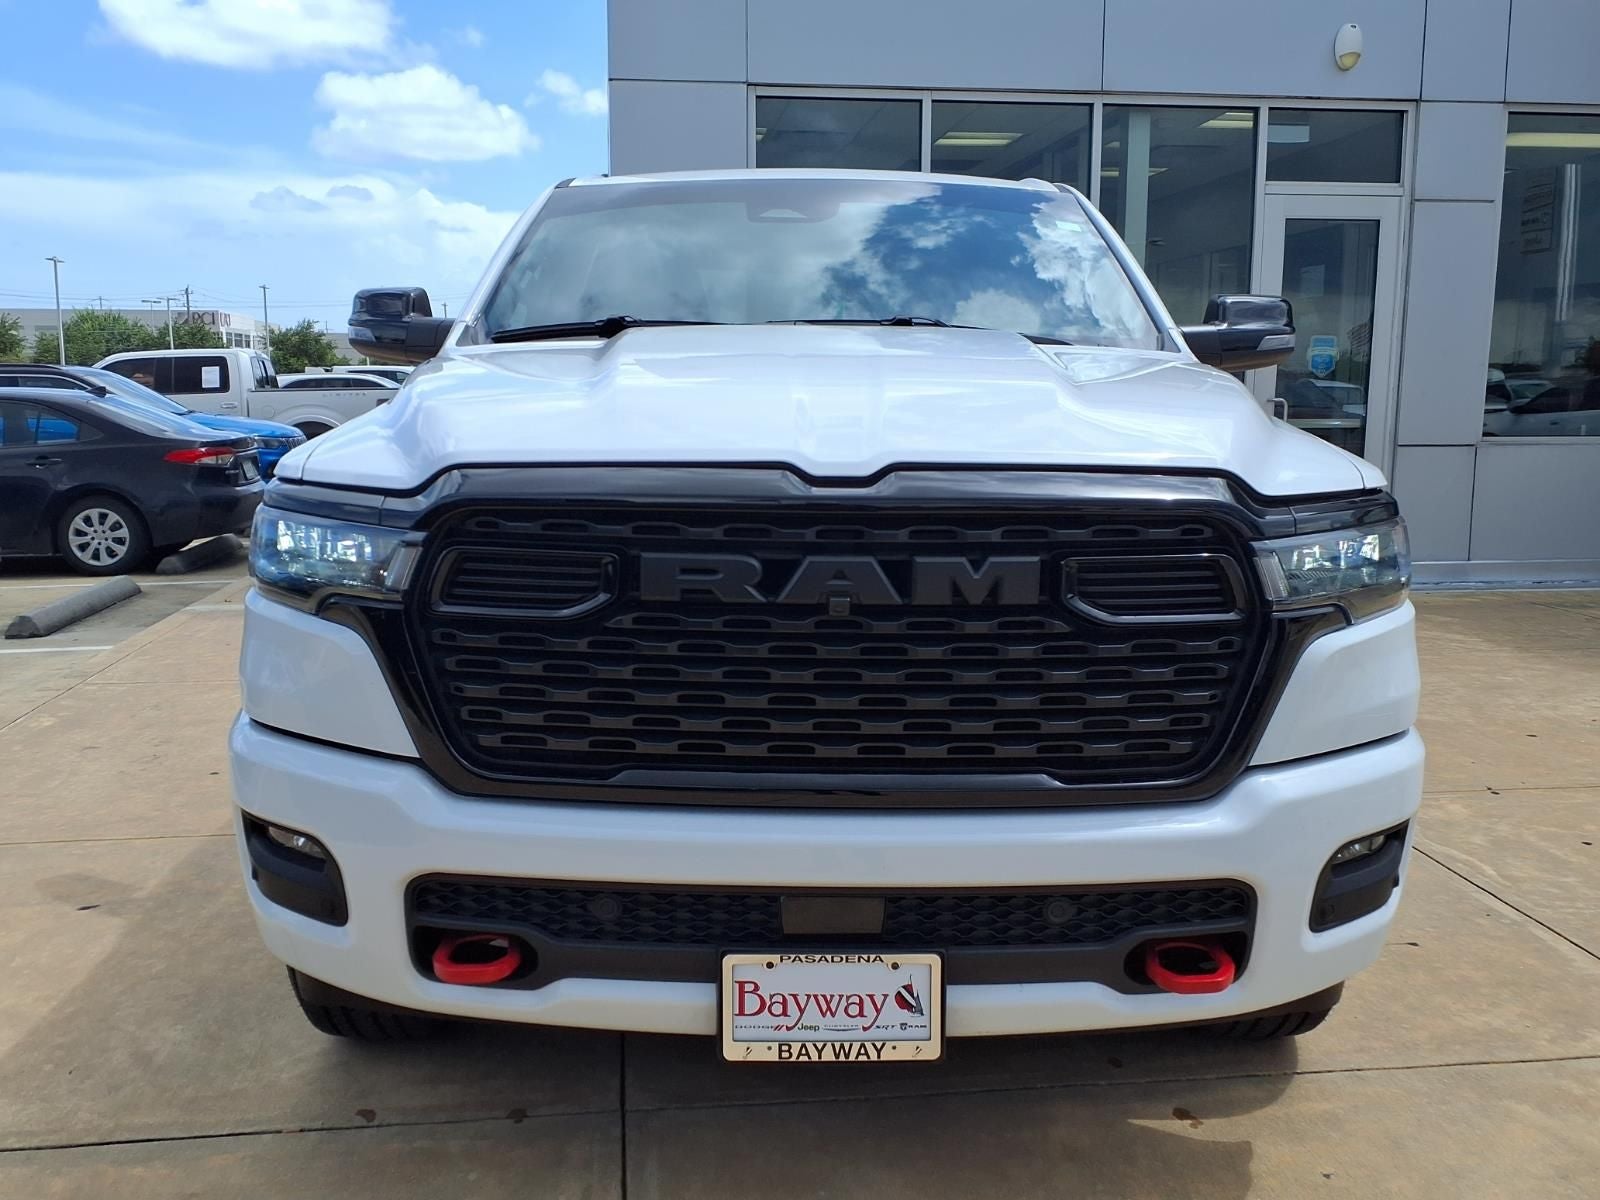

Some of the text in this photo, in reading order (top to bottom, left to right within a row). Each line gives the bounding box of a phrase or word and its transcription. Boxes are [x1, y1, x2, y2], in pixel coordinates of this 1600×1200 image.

[640, 551, 1041, 605] RAM
[779, 955, 885, 964] PASADENA
[733, 980, 890, 1032] Bayway
[797, 1022, 820, 1032] Jeep
[777, 1042, 887, 1060] BAYWAY
